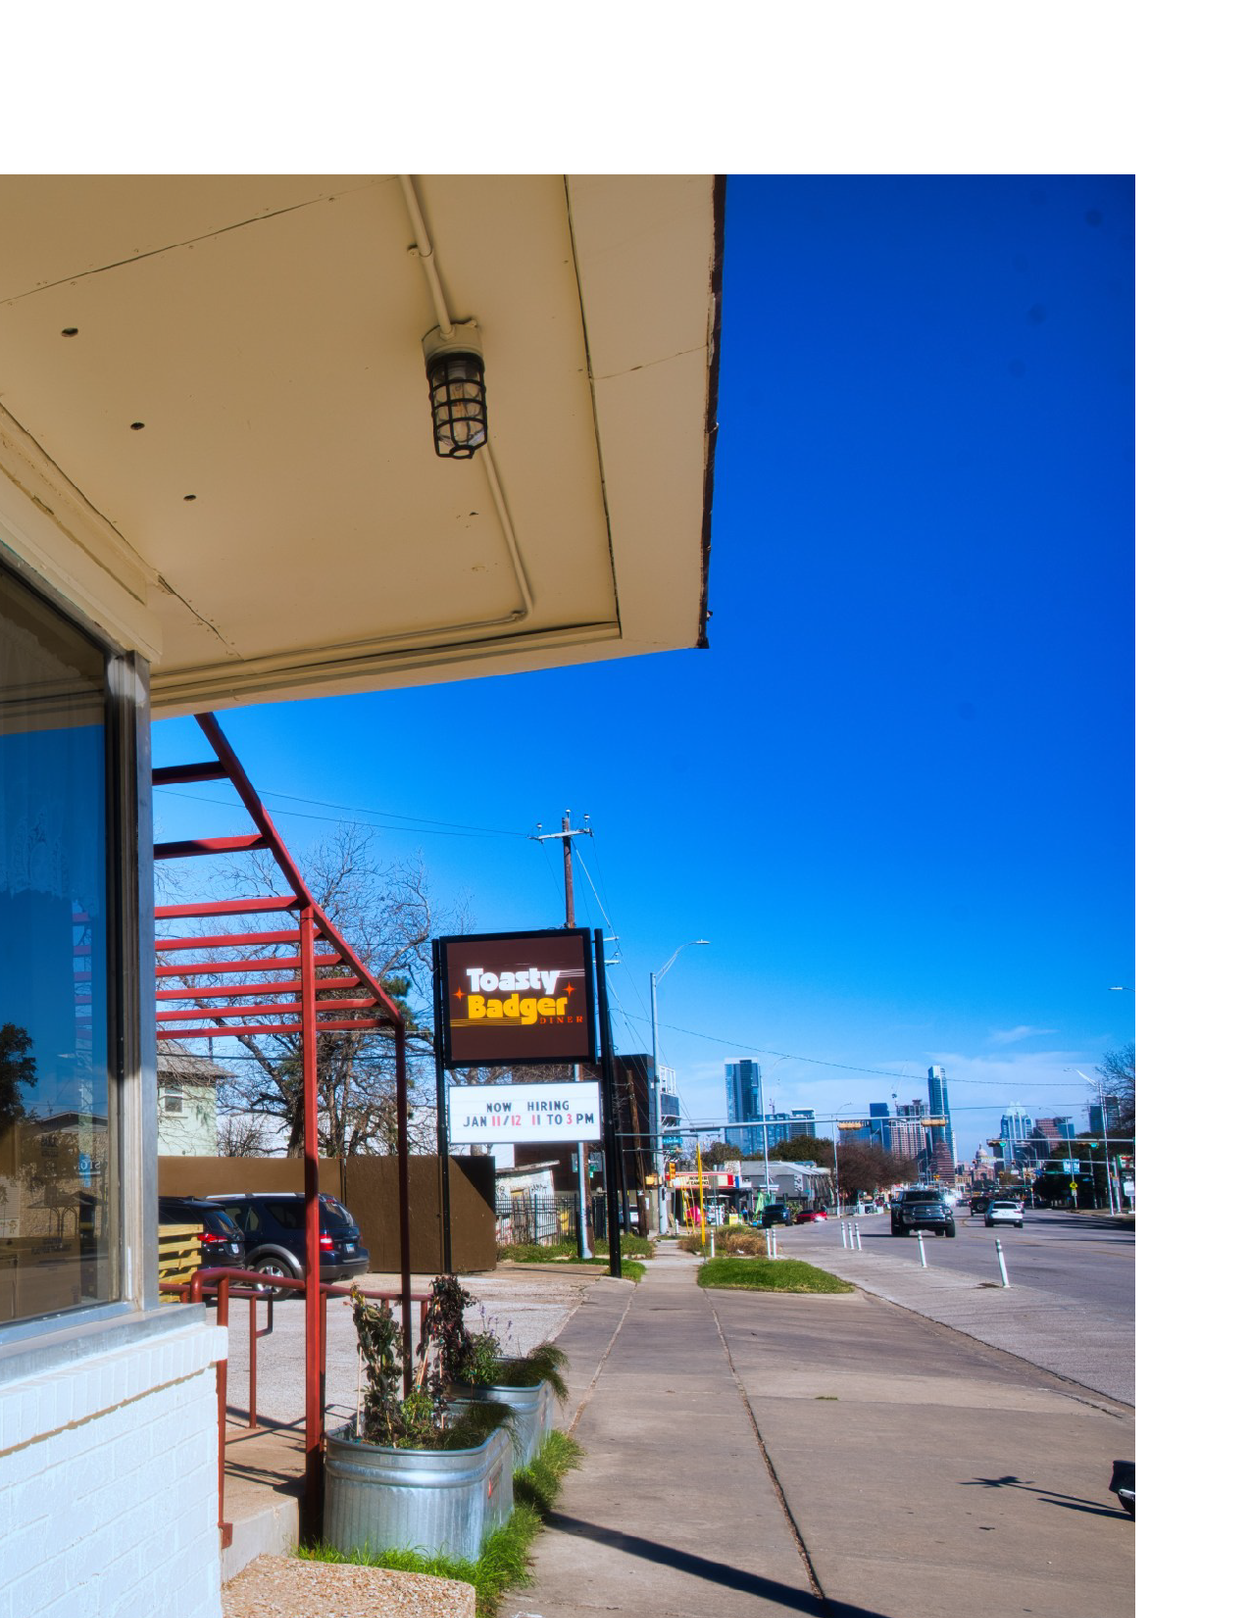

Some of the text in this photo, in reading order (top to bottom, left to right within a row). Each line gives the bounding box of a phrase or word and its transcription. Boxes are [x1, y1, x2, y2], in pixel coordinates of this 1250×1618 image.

[466, 967, 560, 995] Toasty
[467, 993, 568, 1025] Badger
[539, 1015, 583, 1025] DINER
[486, 1100, 570, 1113] NOW HIRING
[463, 1115, 487, 1127] JAN
[547, 1113, 563, 1125] TO
[576, 1112, 594, 1125] PM
